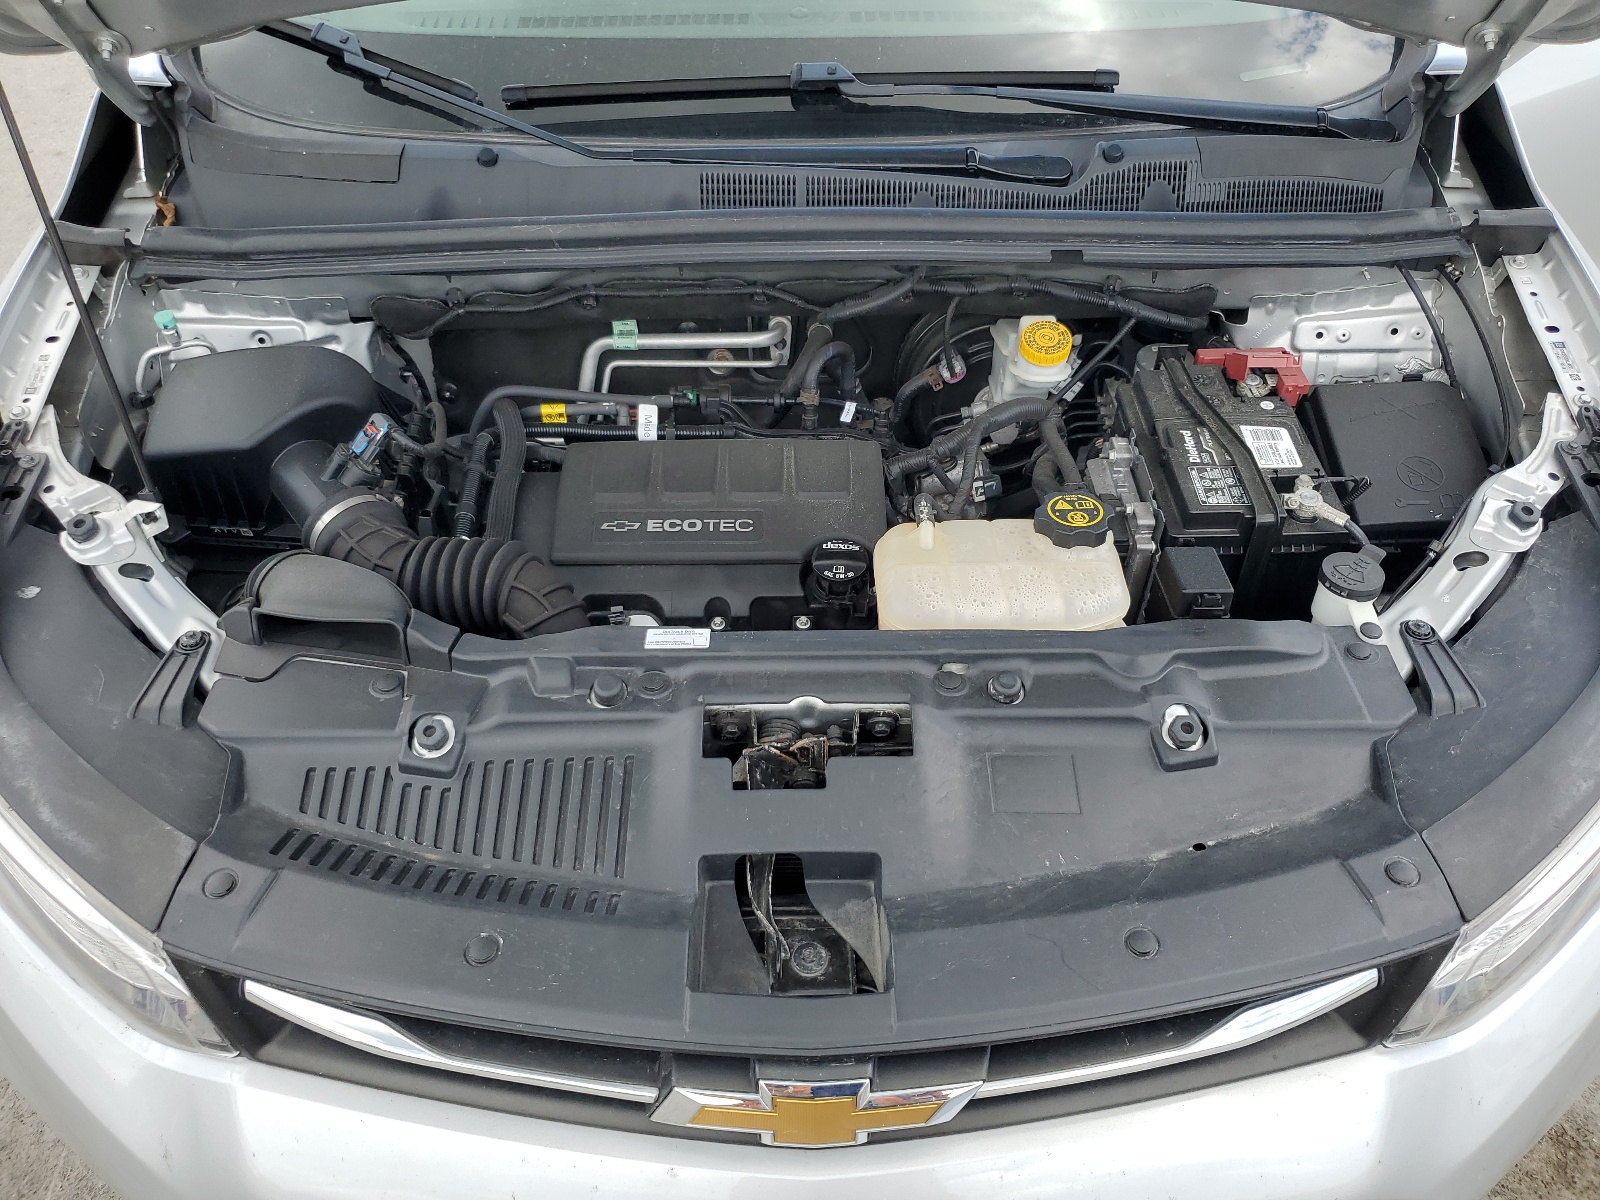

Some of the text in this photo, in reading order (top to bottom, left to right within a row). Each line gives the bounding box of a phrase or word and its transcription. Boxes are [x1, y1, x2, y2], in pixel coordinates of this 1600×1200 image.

[1180, 430, 1200, 463] DieHard
[647, 519, 754, 532] ECOTEC
[823, 541, 860, 551] dexos
